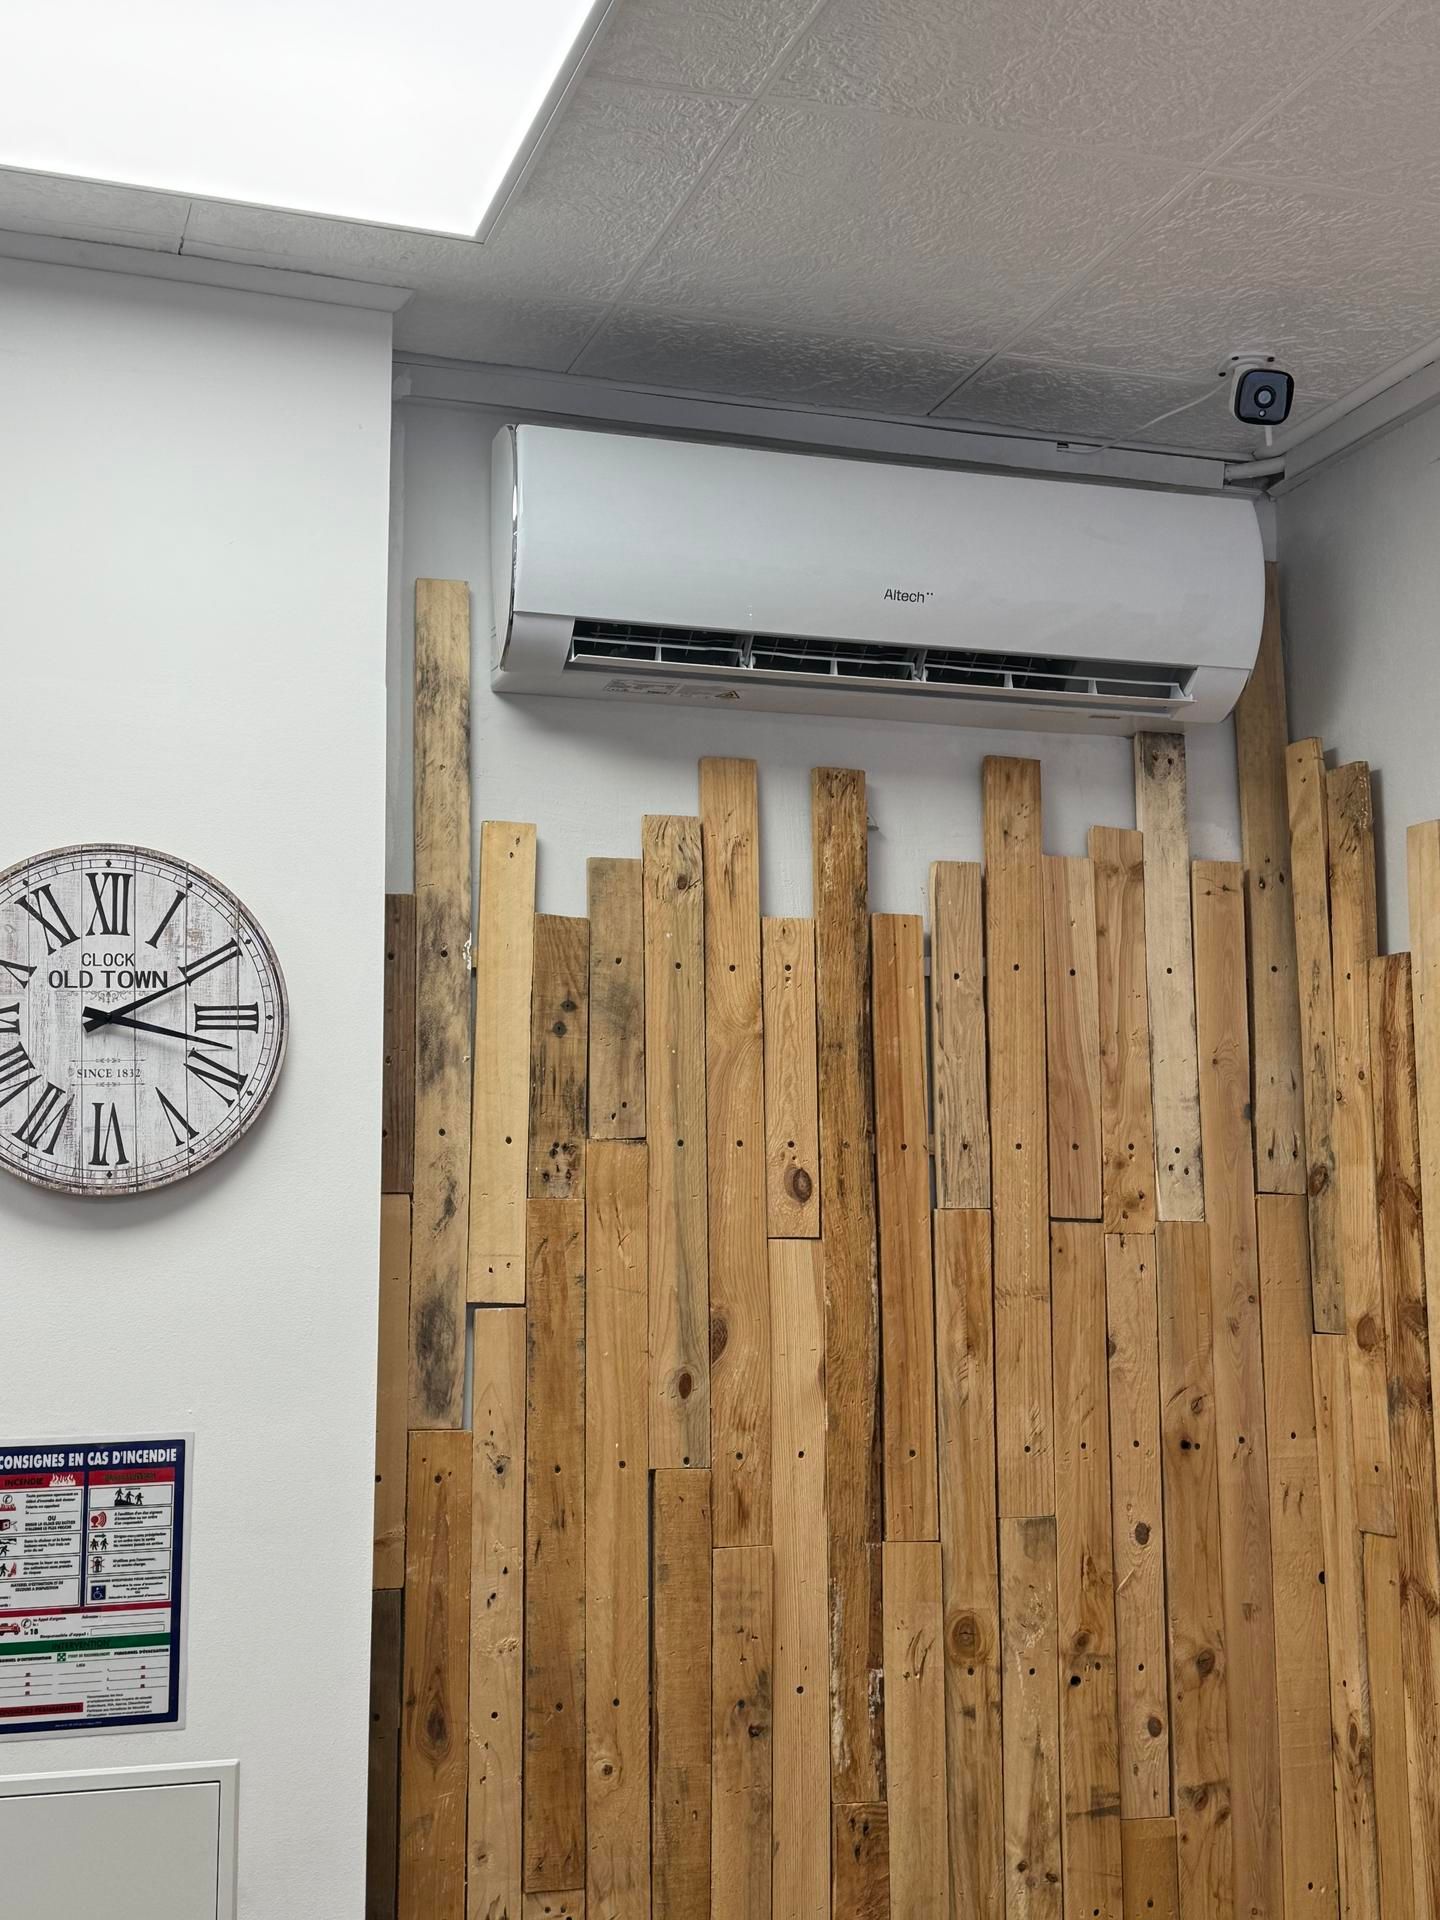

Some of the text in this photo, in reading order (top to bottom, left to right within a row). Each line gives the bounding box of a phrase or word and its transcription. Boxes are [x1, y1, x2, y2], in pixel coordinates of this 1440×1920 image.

[884, 588, 925, 604] Altech
[85, 872, 133, 936] XII
[81, 953, 135, 967] CLOCK
[48, 970, 93, 988] OLD
[101, 970, 168, 988] TOWN
[77, 1069, 112, 1079] SINCE
[68, 1453, 84, 1467] EN
[87, 1451, 109, 1466] CAS
[112, 1448, 177, 1464] D'INCENDIE
